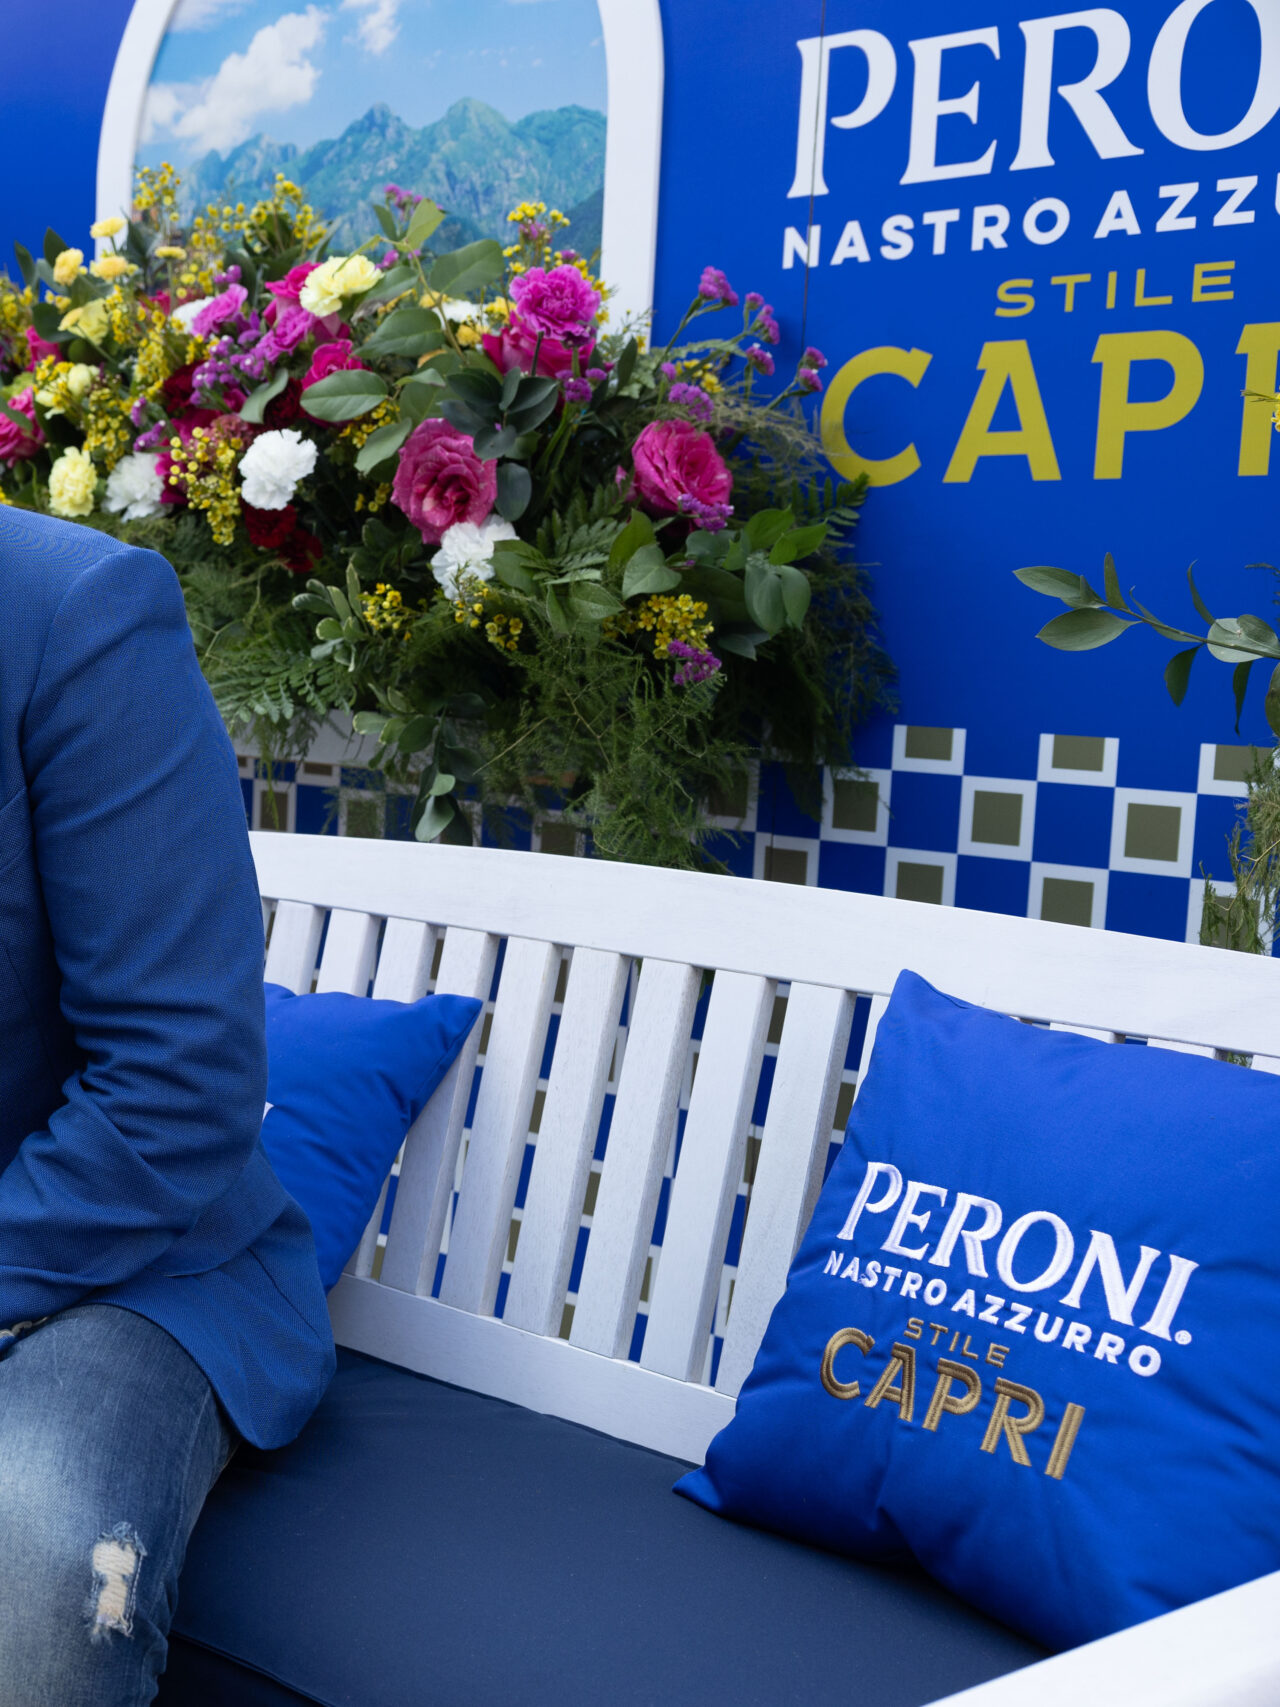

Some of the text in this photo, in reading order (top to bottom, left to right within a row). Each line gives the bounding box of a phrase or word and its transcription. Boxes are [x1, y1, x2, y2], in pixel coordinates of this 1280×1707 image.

[787, 0, 1280, 198] PERO
[782, 172, 1280, 269] NASTRO AZZ
[994, 261, 1236, 318] STILE
[823, 1251, 1162, 1377] NASTRO AZZURRO
[836, 1161, 1200, 1343] PERONI
[820, 1327, 1086, 1480] CAPRI
[903, 1317, 1011, 1369] STILE
